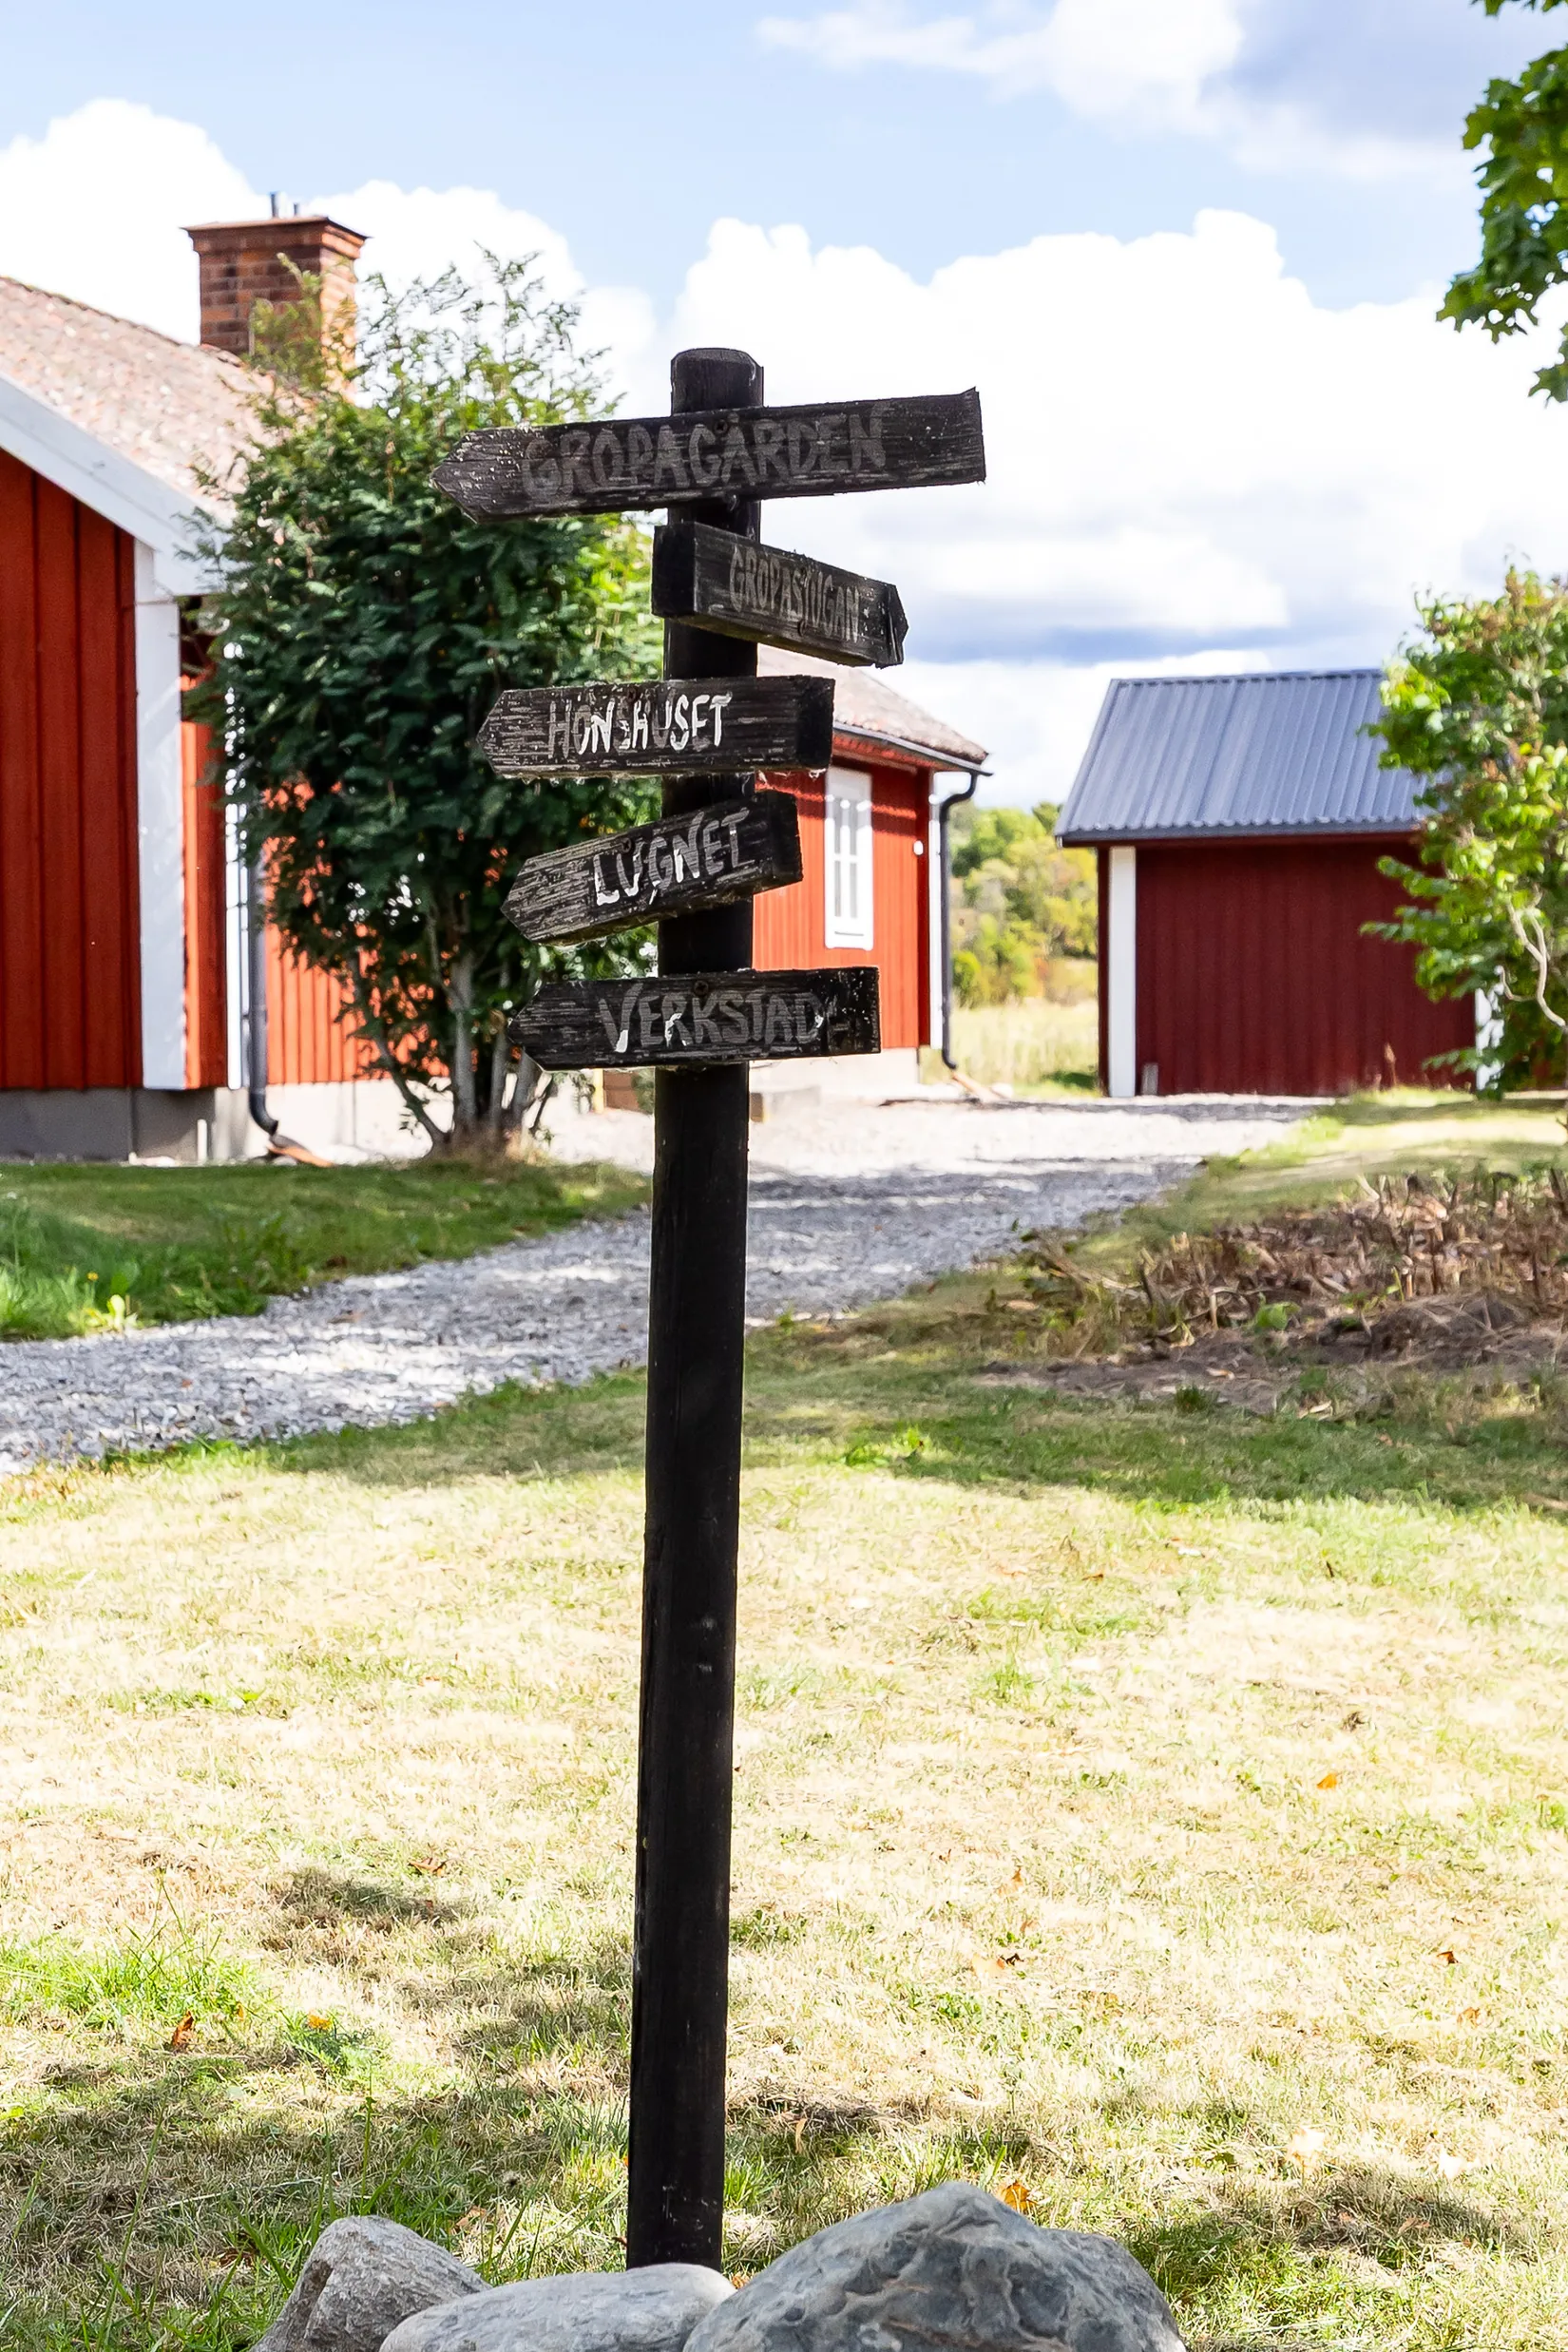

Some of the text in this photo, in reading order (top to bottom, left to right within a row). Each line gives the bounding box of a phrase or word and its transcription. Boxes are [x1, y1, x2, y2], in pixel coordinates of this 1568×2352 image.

[522, 402, 891, 501] GROPAGÅRDEN
[593, 808, 749, 906] LUGNET
[599, 983, 824, 1052] VERKSTAD
